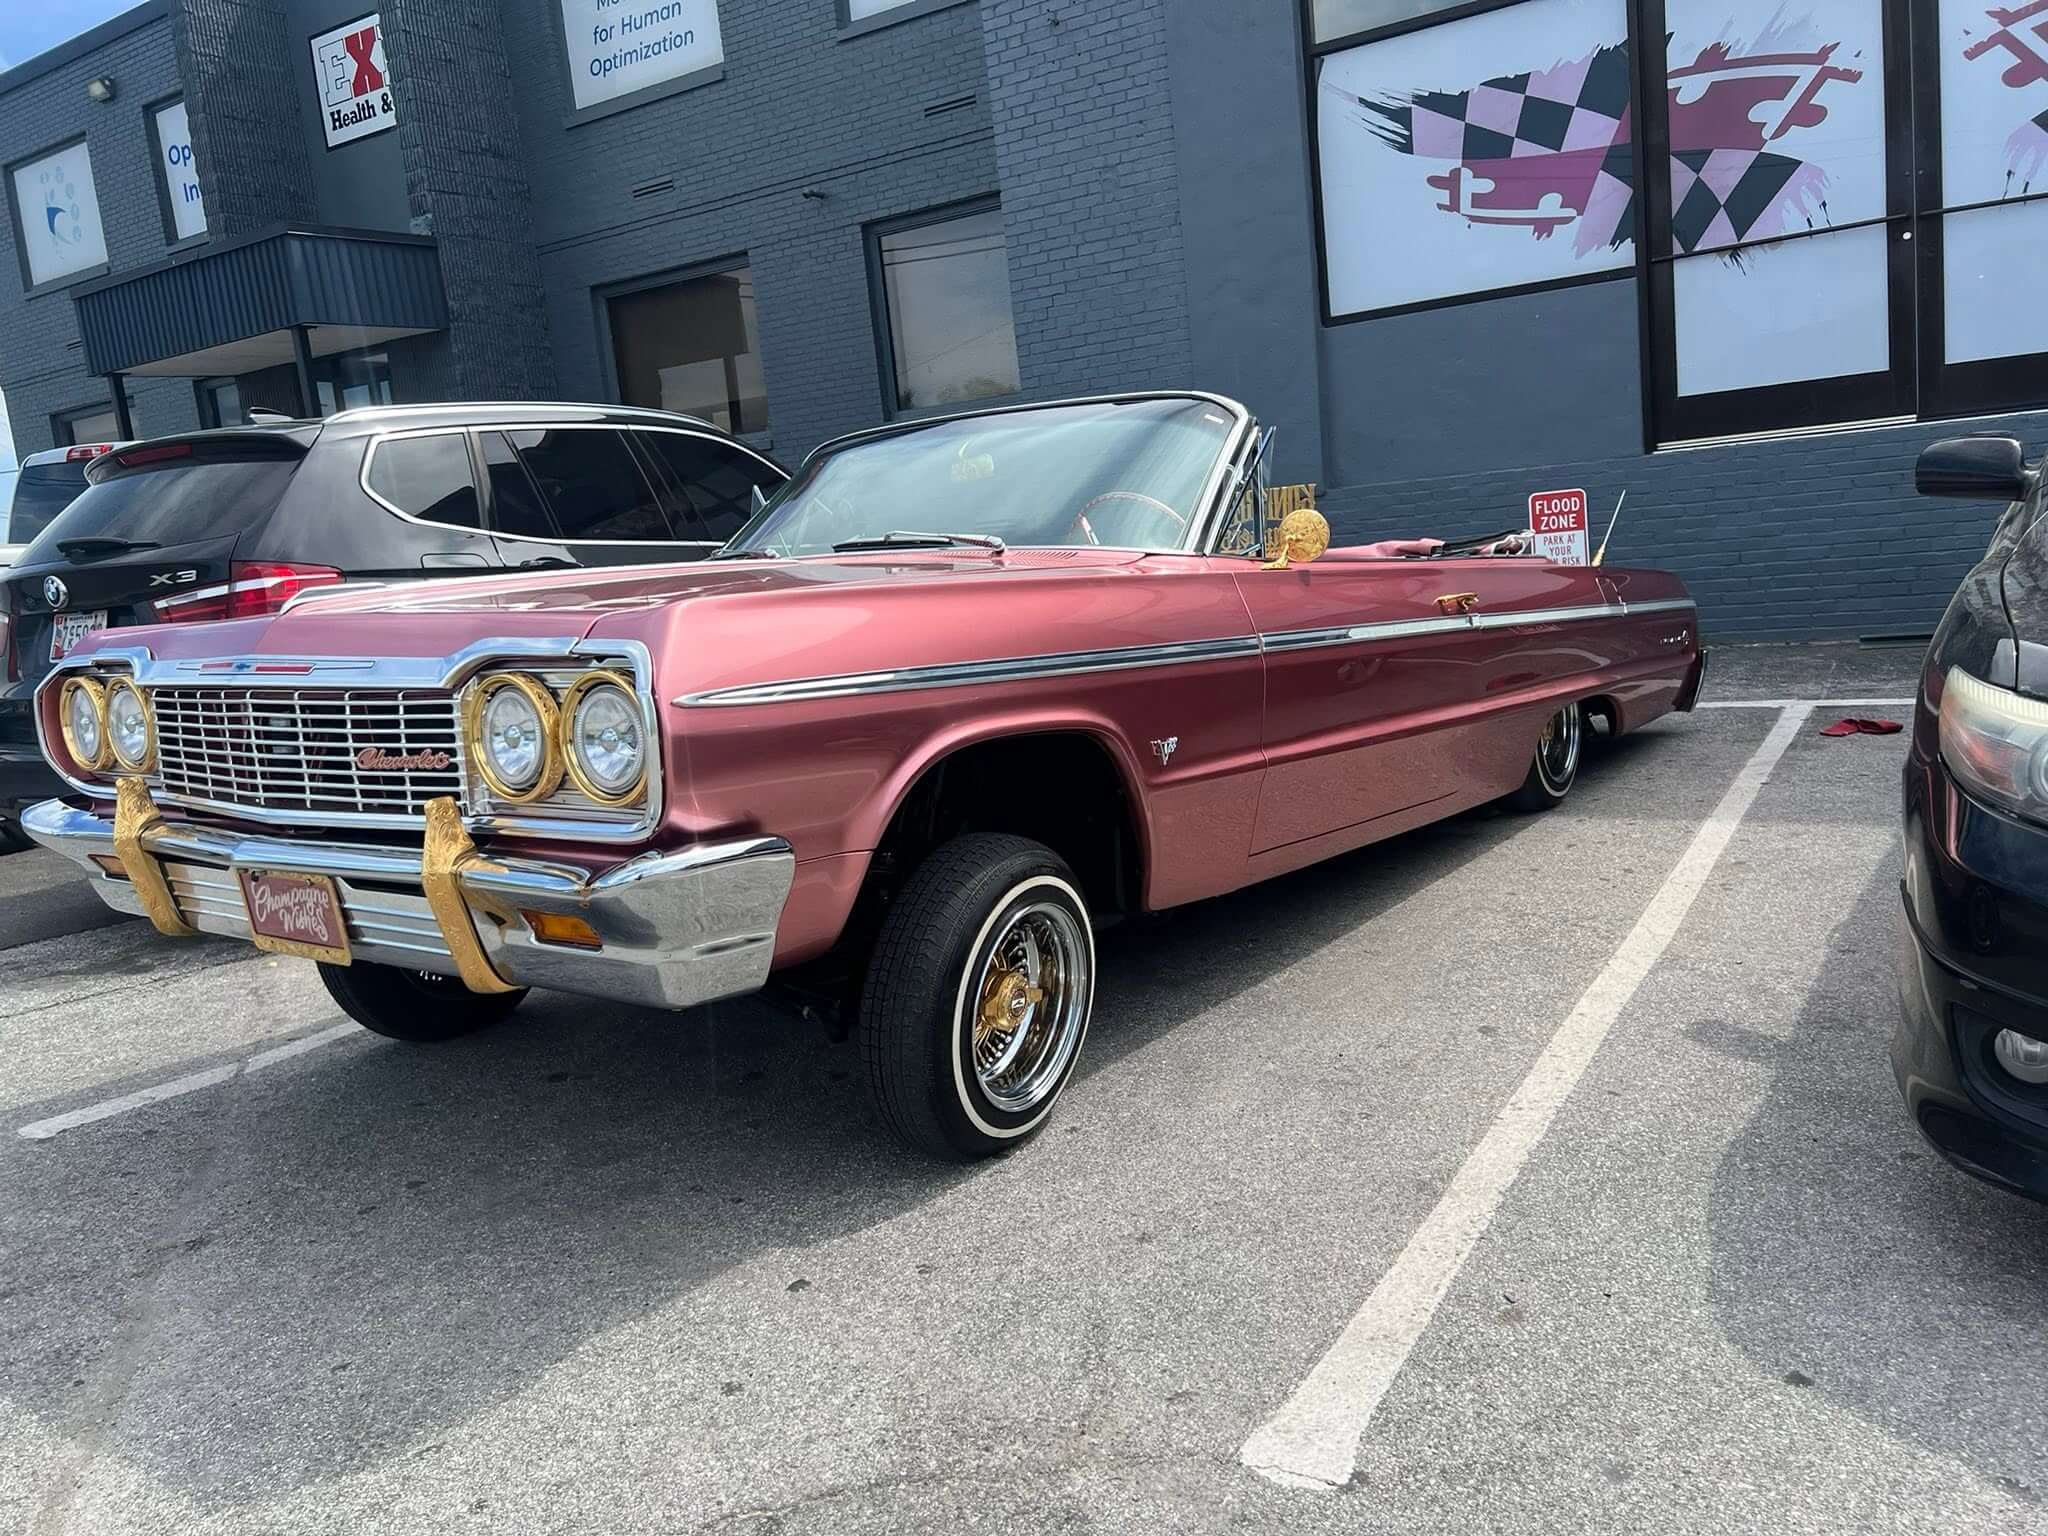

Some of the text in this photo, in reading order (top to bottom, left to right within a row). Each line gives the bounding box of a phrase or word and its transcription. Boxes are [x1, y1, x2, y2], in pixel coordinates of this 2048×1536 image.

[593, 2, 682, 46] for Human
[590, 29, 695, 78] Optimization
[318, 24, 391, 107] EX
[329, 92, 394, 131] Health &
[1535, 497, 1580, 515] FLOOD
[1540, 513, 1578, 531] ZONE
[1543, 534, 1576, 546] PARK AT
[1549, 546, 1572, 557] YOUR
[1562, 556, 1581, 566] RISK
[150, 570, 197, 586] X3
[356, 747, 450, 769] Chevrolet
[251, 882, 329, 922] Champagne
[279, 905, 329, 942] Wishes
